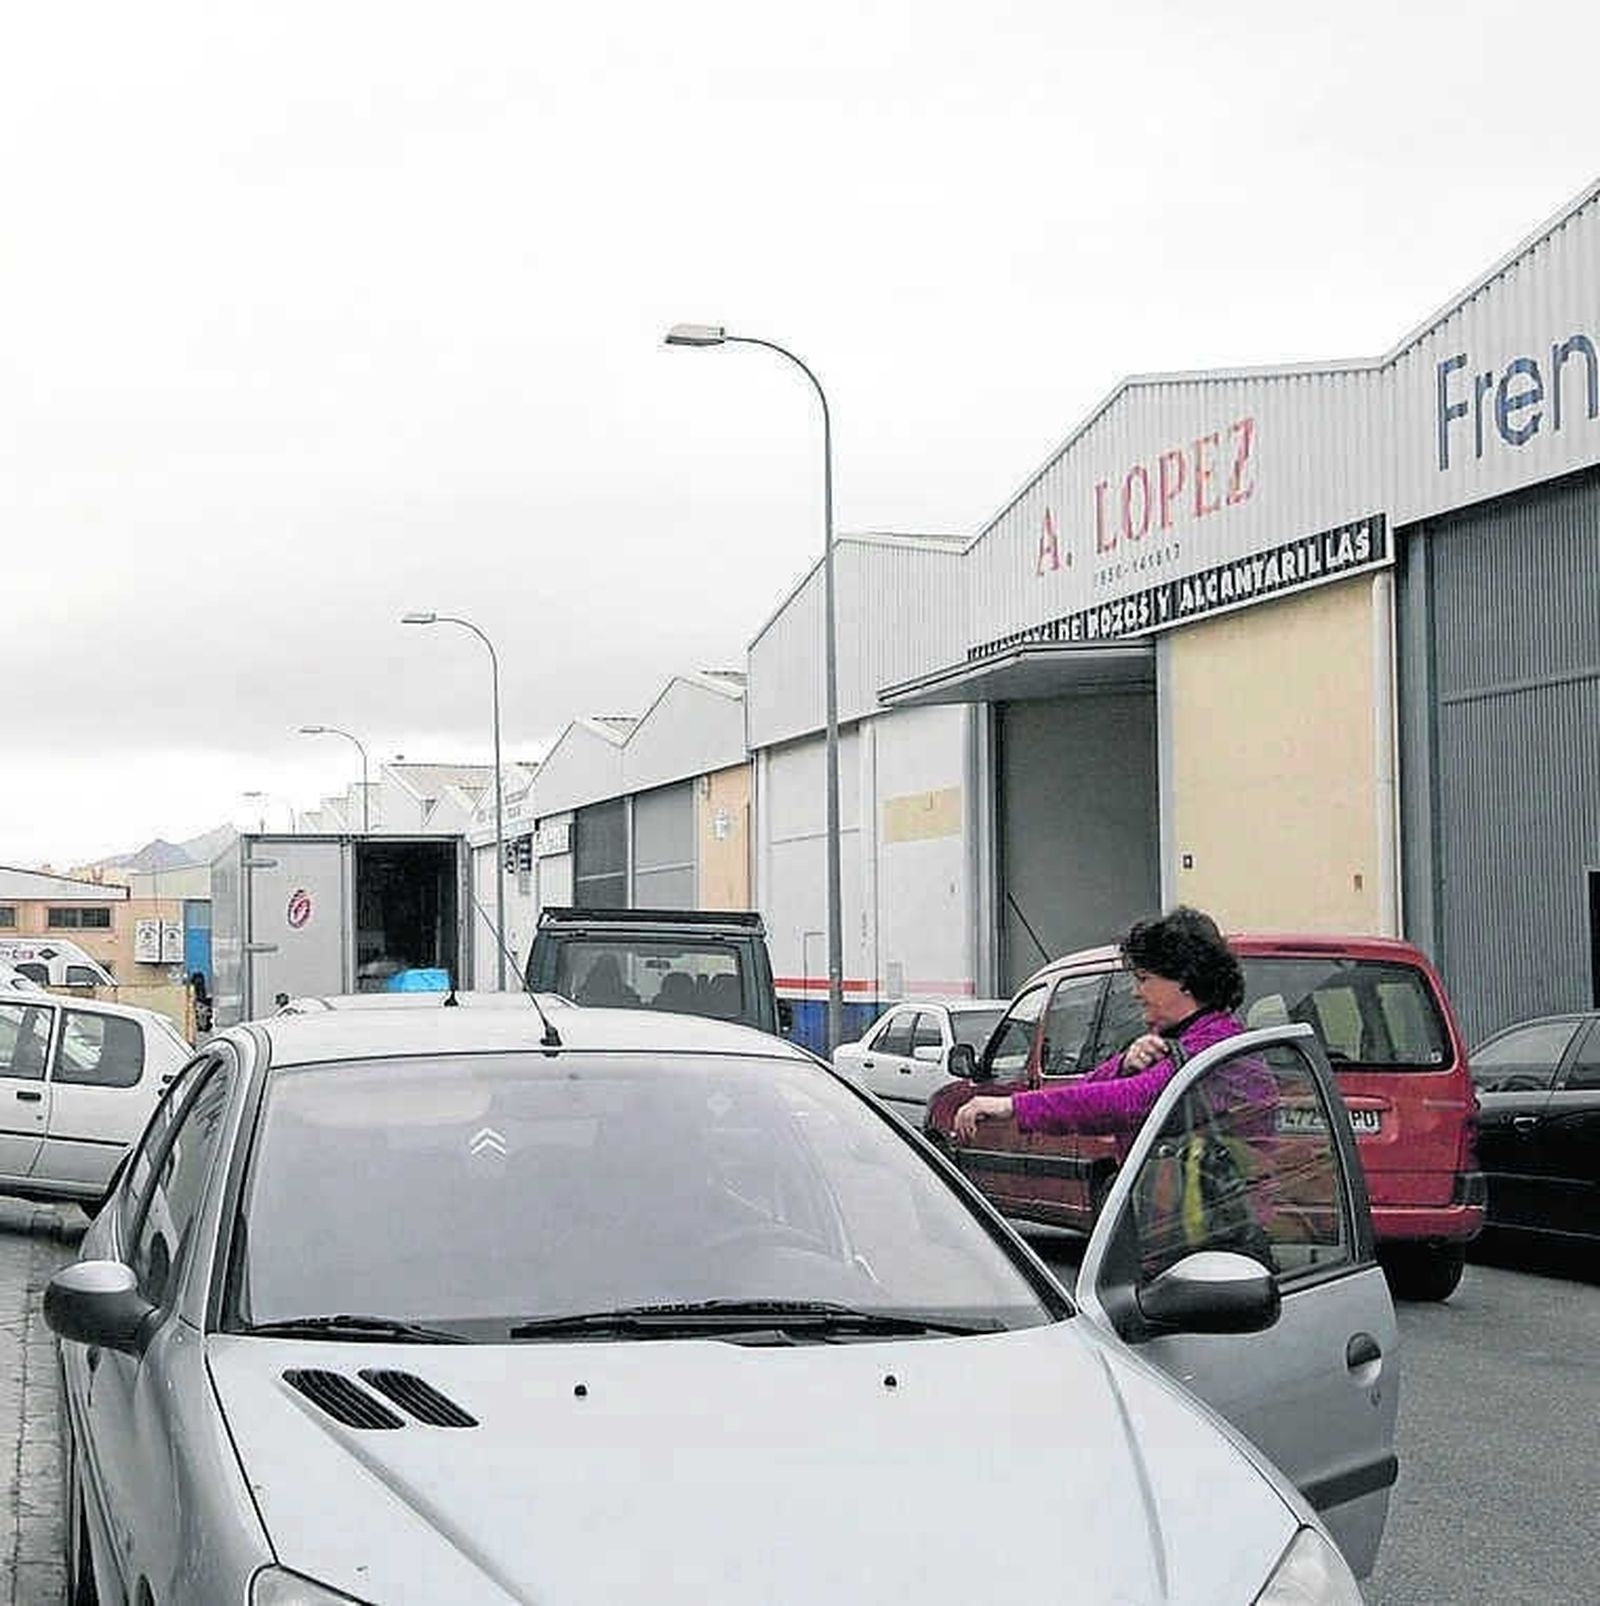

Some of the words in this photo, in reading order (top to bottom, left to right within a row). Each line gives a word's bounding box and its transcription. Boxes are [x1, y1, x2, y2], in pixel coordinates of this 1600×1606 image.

[1437, 334, 1599, 471] Fren
[1037, 505, 1073, 576] A.
[1095, 416, 1256, 554] LOPEZ
[1157, 588, 1171, 618] Y
[1180, 526, 1370, 612] ALCANTARILLAS
